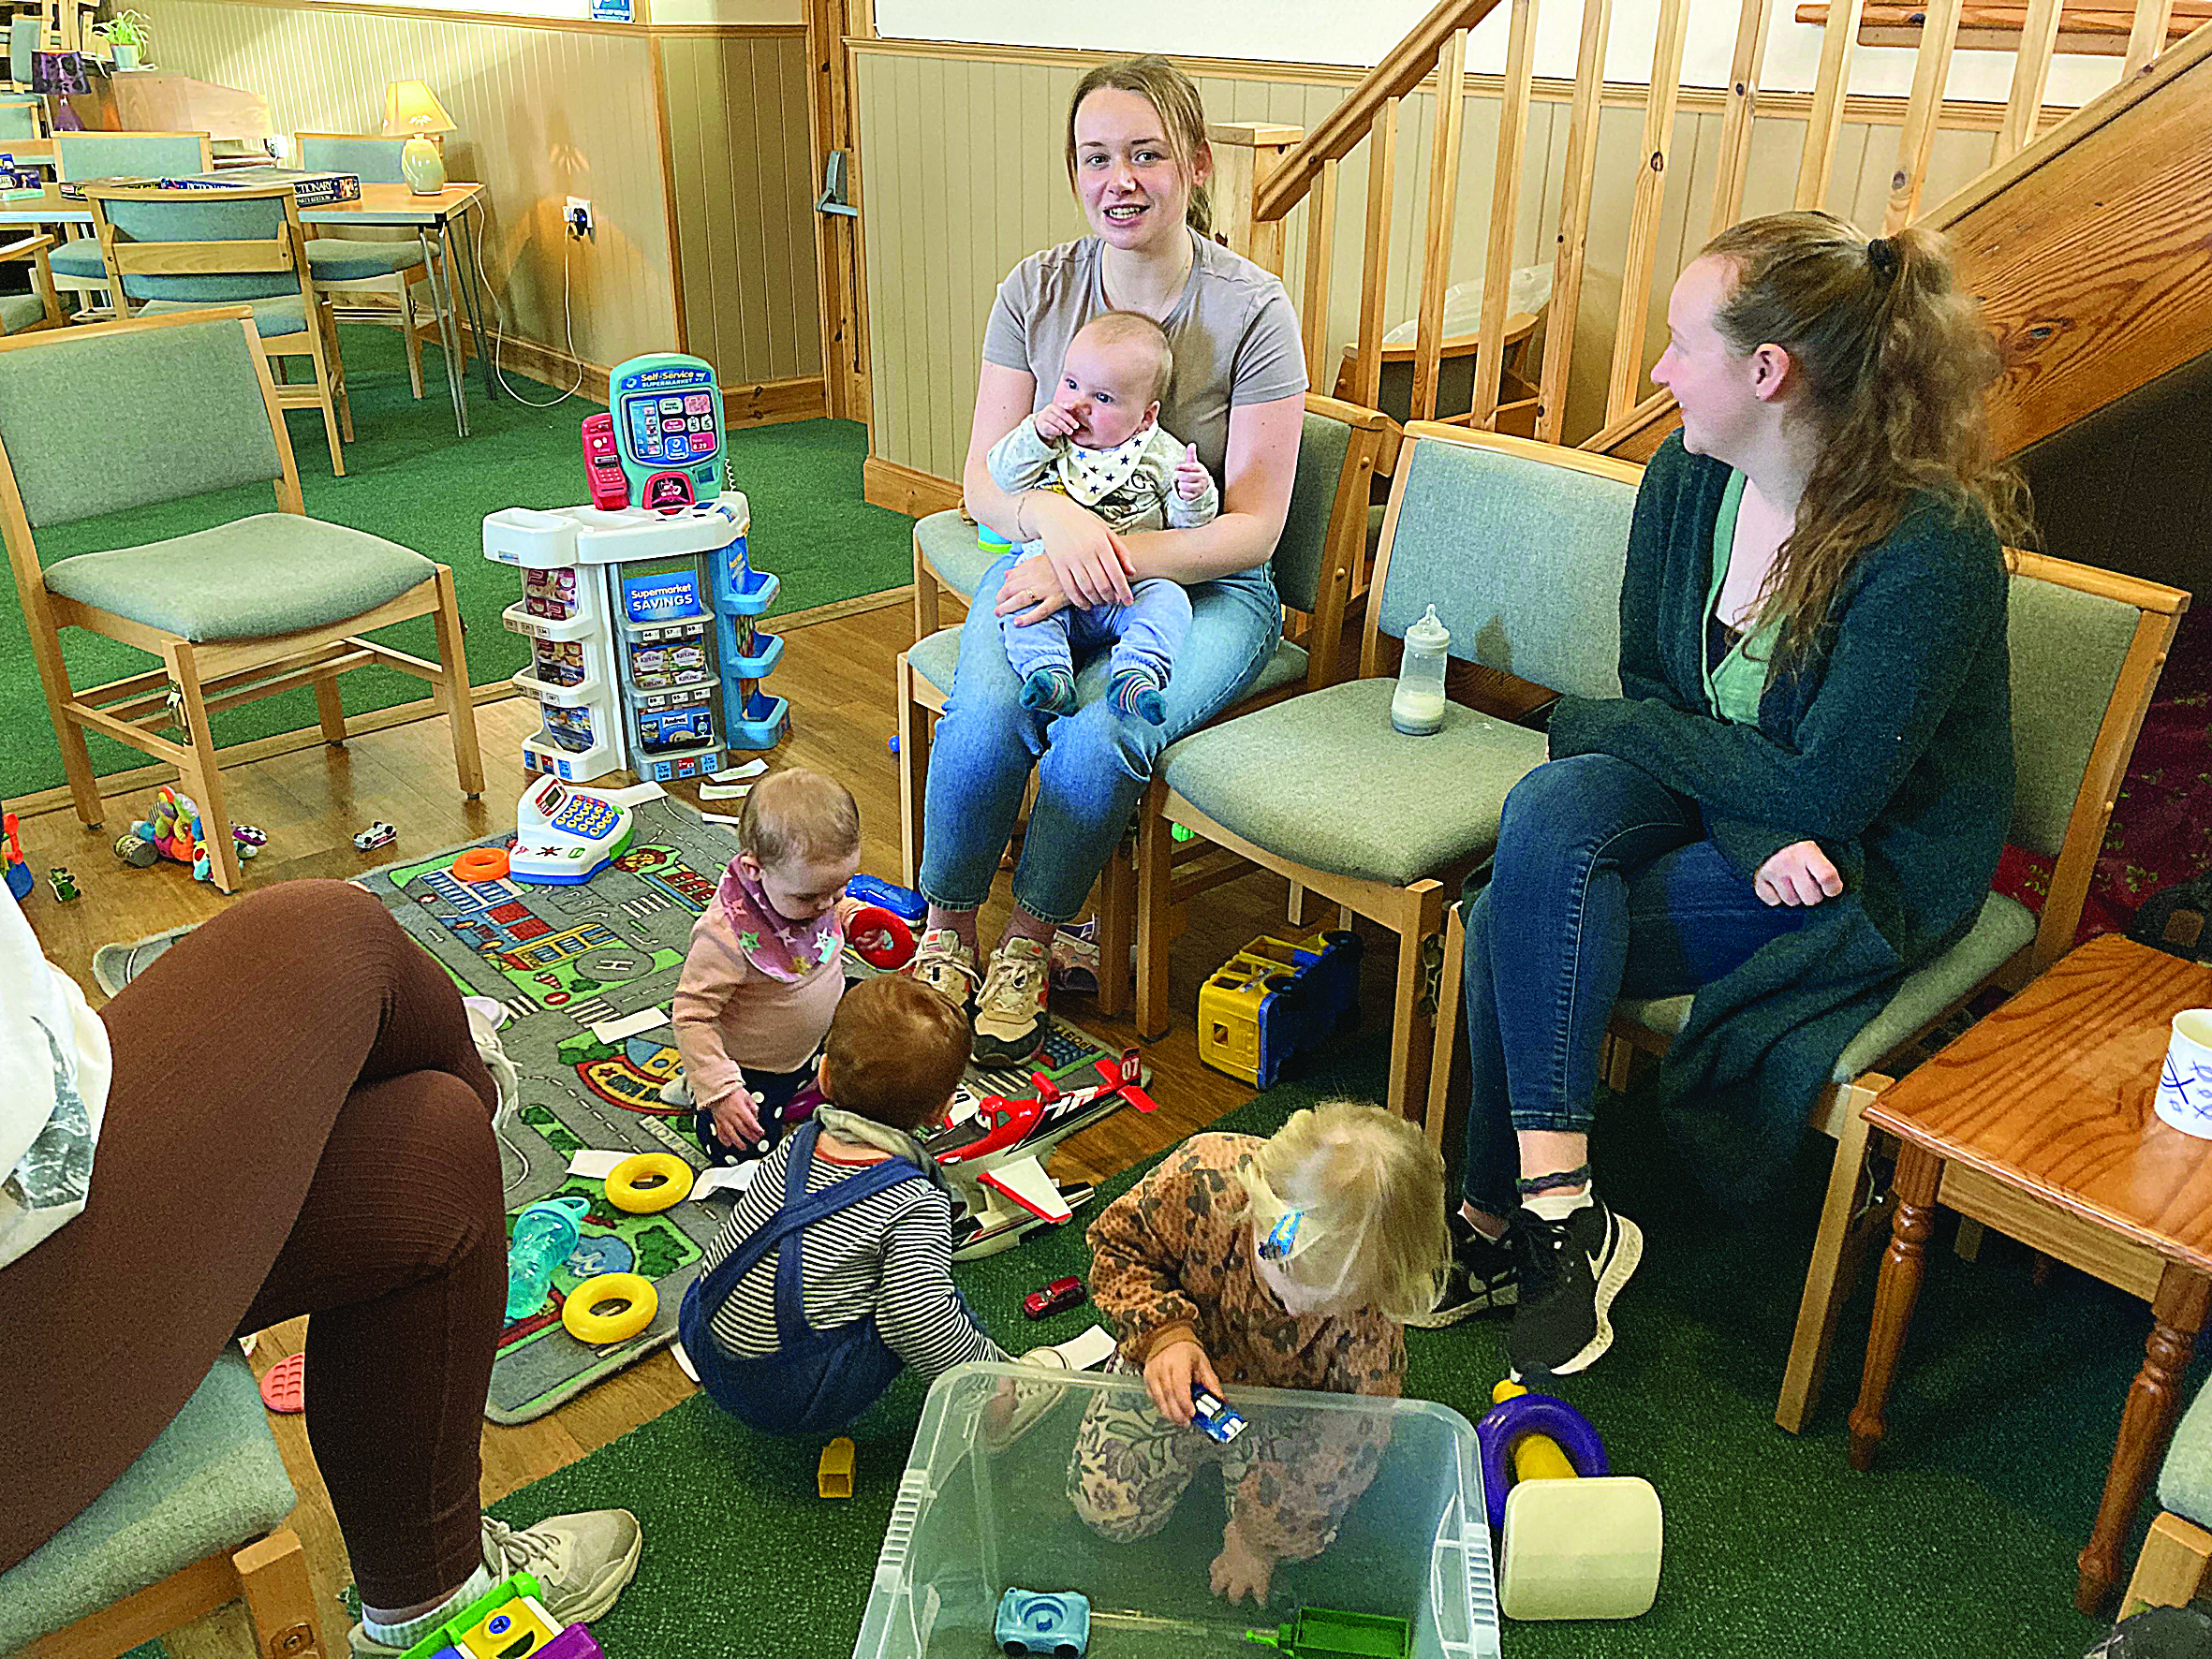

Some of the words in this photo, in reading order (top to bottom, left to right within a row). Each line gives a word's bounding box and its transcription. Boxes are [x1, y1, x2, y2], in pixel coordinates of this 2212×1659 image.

[294, 180, 332, 194] CTIONARY
[641, 371, 695, 382] Self-Service
[641, 378, 693, 388] SUPERMARKET
[631, 583, 692, 599] Supermarket
[632, 595, 693, 611] SAVINGS
[1122, 1058, 1140, 1080] 07
